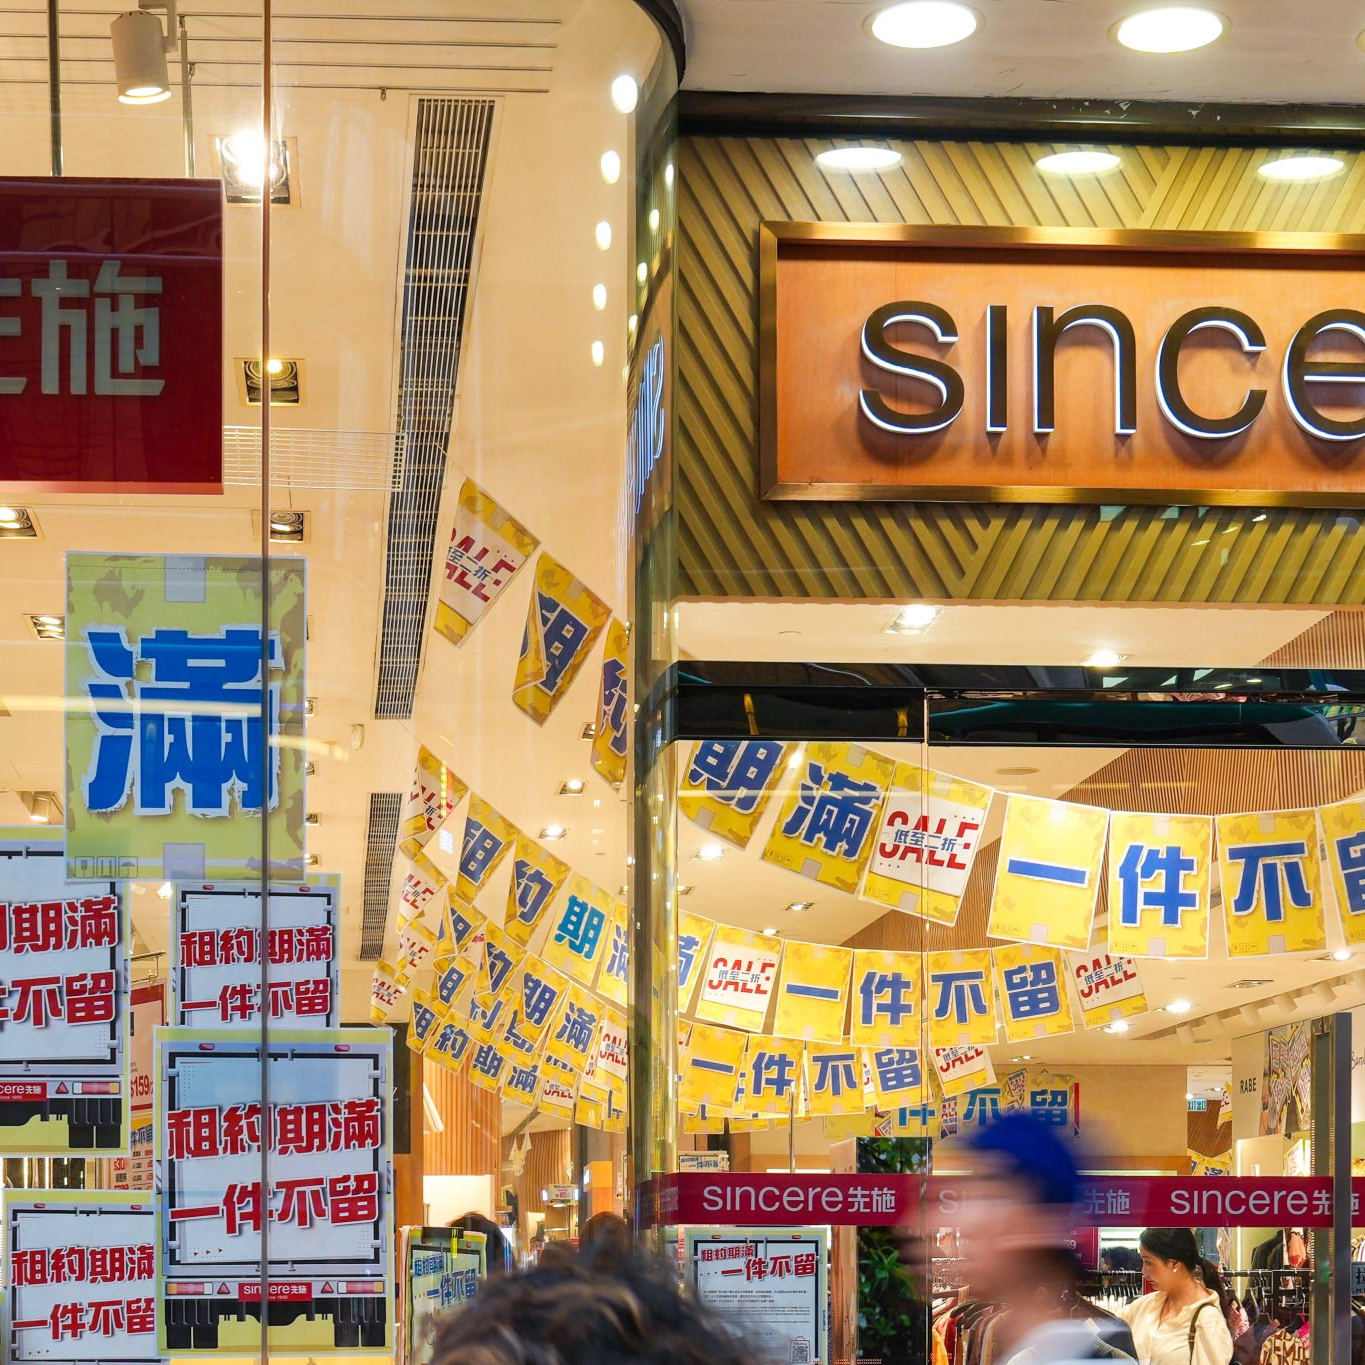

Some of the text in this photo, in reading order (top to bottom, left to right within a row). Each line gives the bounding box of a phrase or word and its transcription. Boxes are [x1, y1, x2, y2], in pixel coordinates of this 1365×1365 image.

[878, 810, 980, 871] SALE
[893, 829, 957, 853] 低至二折
[179, 924, 334, 969] 租約期滿
[181, 977, 331, 1023] 一件不留
[1240, 1077, 1257, 1095] RABE
[166, 1096, 382, 1161] 租約期滿
[168, 1171, 380, 1237] 一件不留
[703, 1185, 895, 1214] sincere 先施
[1170, 1188, 1308, 1215] sincere
[700, 1244, 756, 1263] 租約期滿
[720, 1252, 817, 1282] 一件不留
